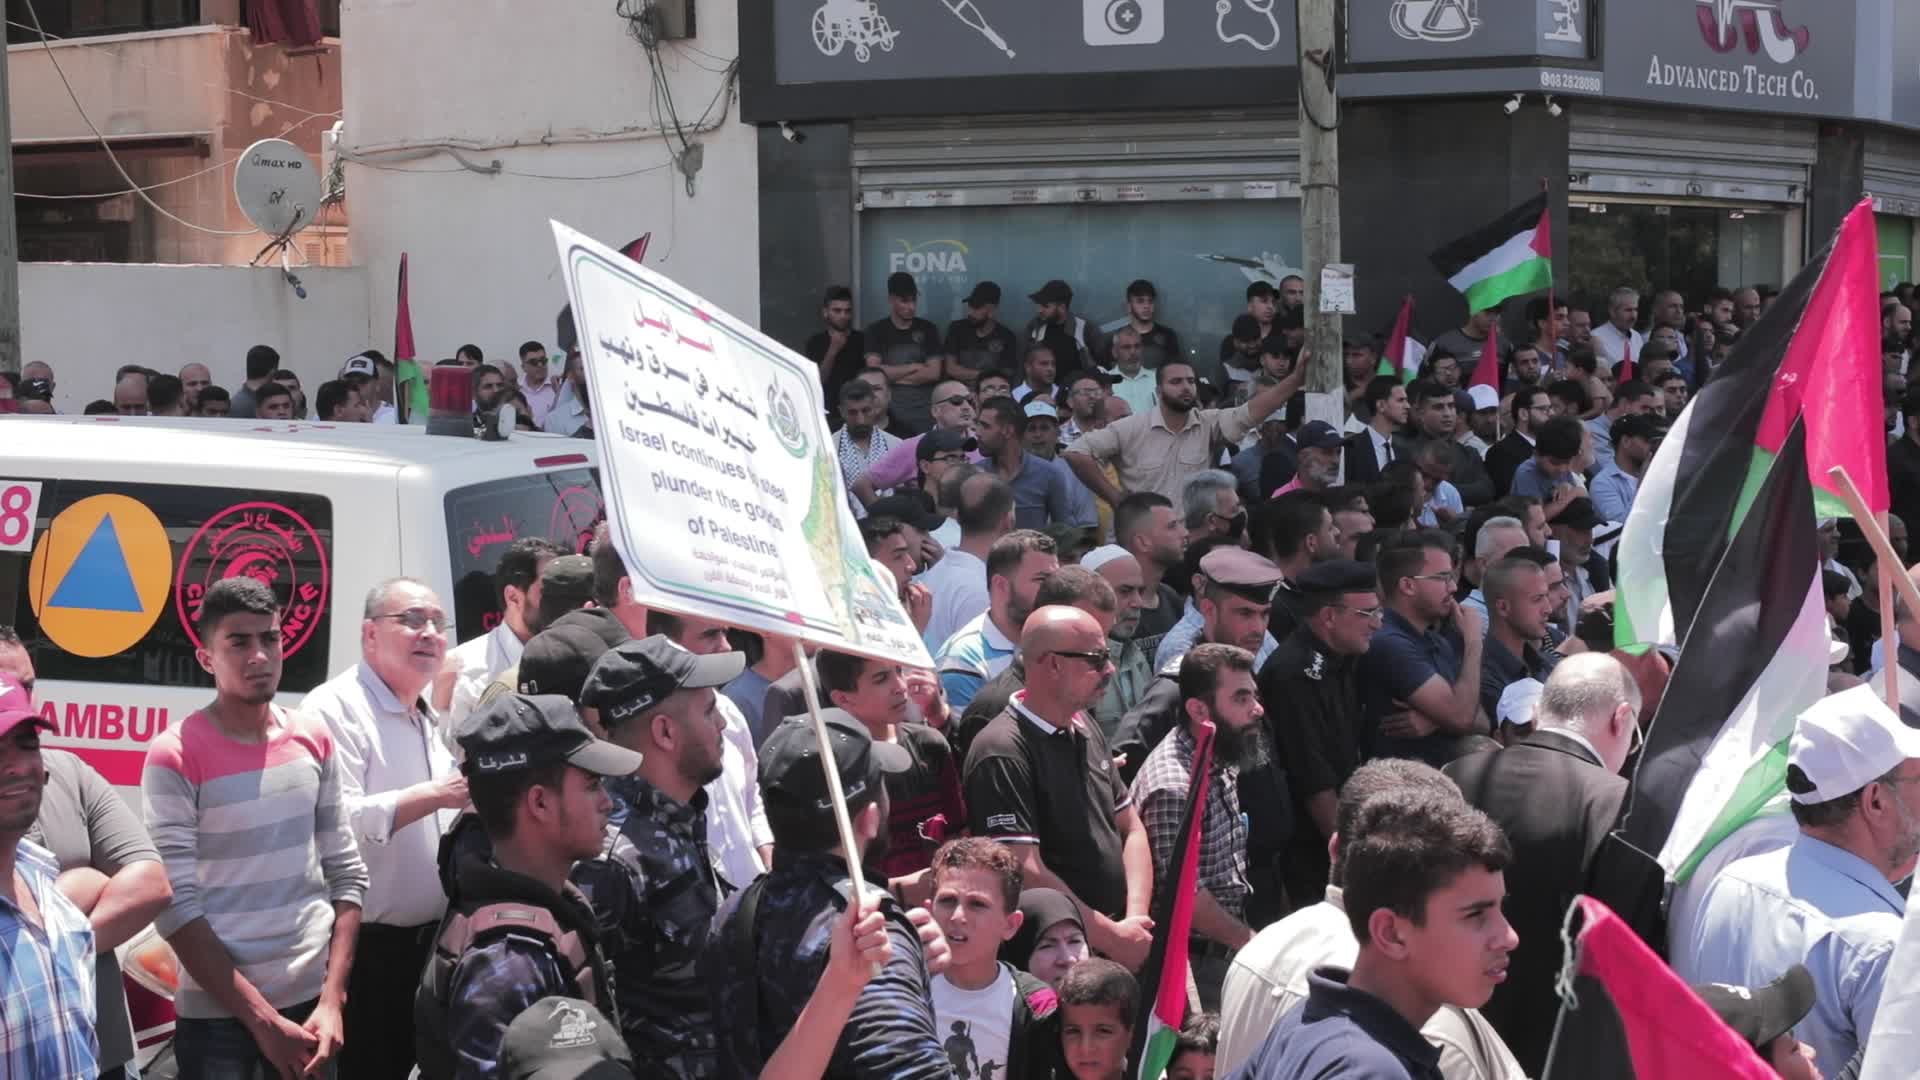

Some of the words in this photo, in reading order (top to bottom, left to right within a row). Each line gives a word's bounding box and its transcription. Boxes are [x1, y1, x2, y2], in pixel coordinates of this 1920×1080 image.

[1647, 55, 1740, 92] ADVANCED
[1743, 64, 1787, 97] TECH
[287, 161, 302, 169] HD
[889, 252, 968, 272] FONA
[624, 380, 700, 430] فلسطين
[618, 419, 668, 453] Israel
[671, 439, 747, 480] continues
[651, 470, 714, 502] plunder
[715, 489, 742, 513] the
[687, 516, 706, 536] of
[708, 519, 779, 558] Palestine
